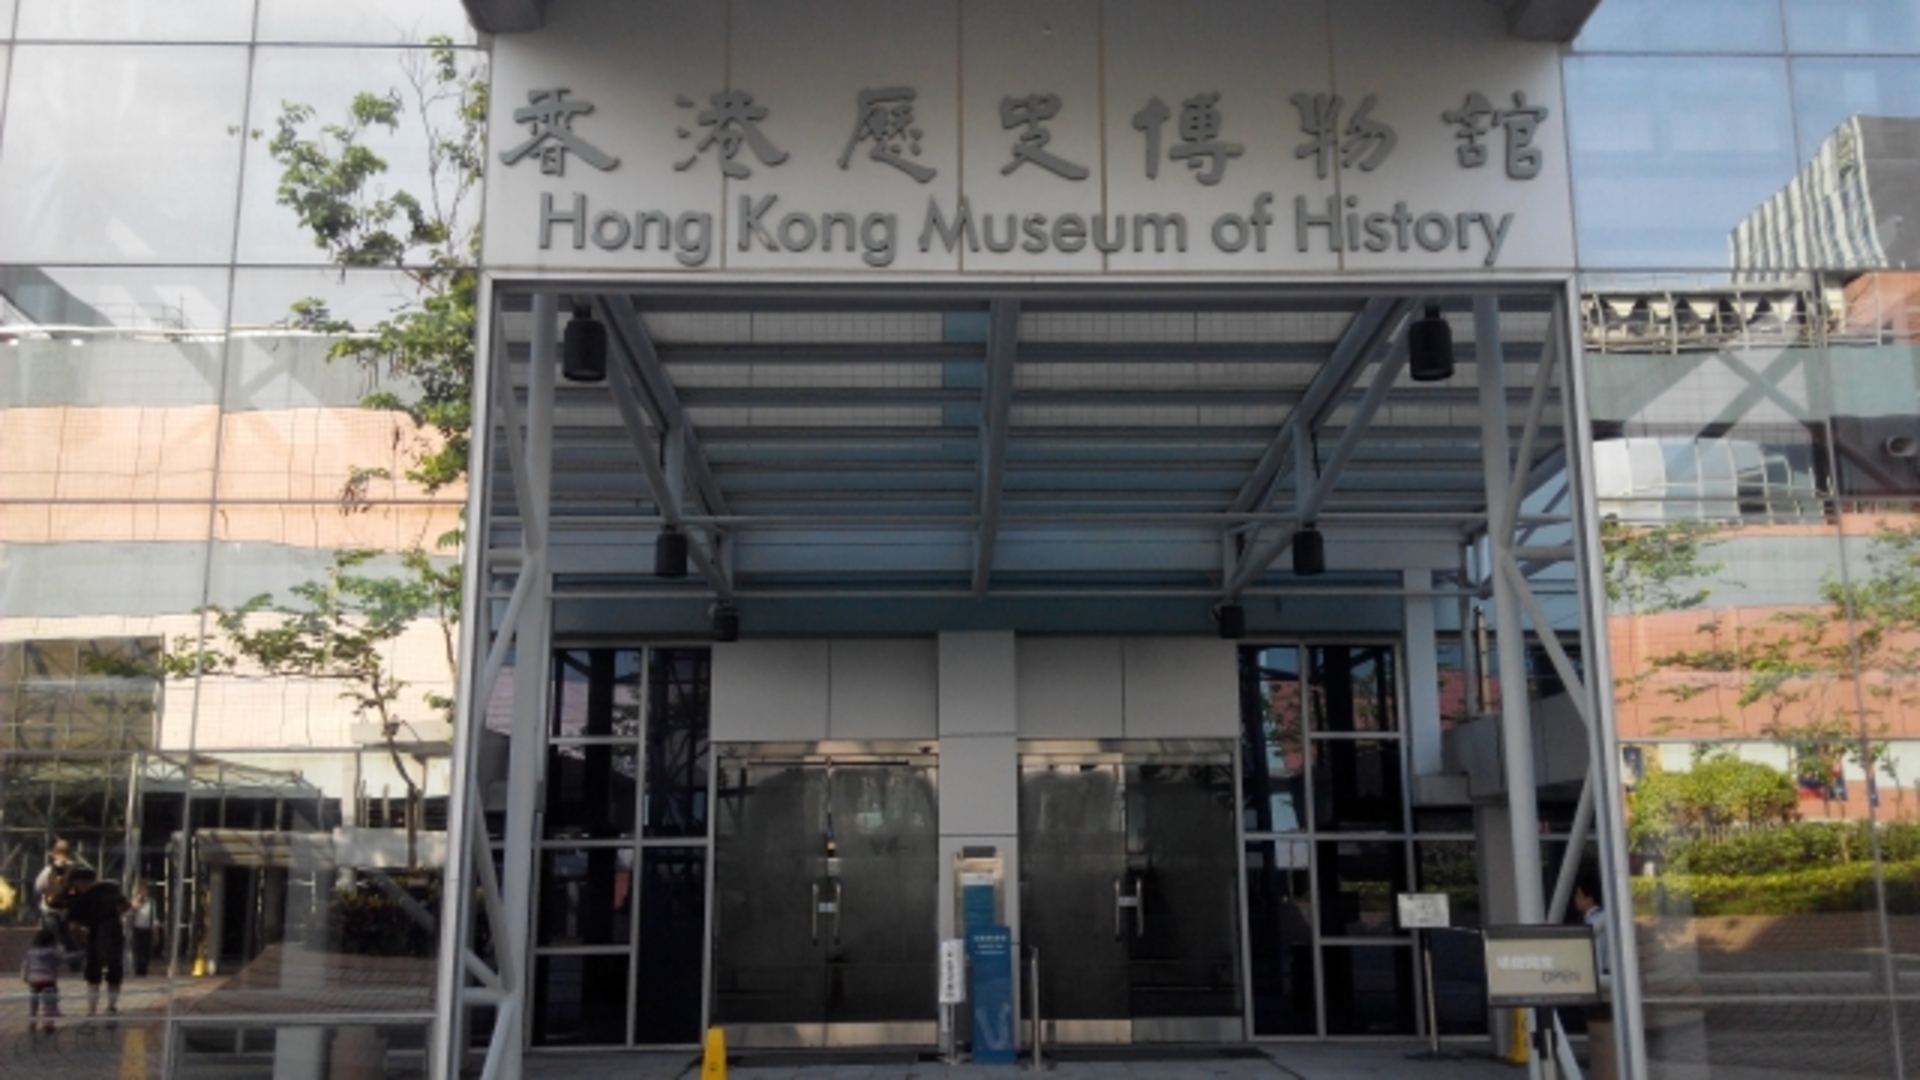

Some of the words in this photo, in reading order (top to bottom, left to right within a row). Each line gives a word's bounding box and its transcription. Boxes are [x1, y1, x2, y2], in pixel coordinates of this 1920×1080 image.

[537, 192, 712, 267] Hong
[737, 194, 898, 267] Kong
[917, 194, 1189, 254] Museum
[1210, 192, 1275, 254] of
[1295, 194, 1515, 268] History
